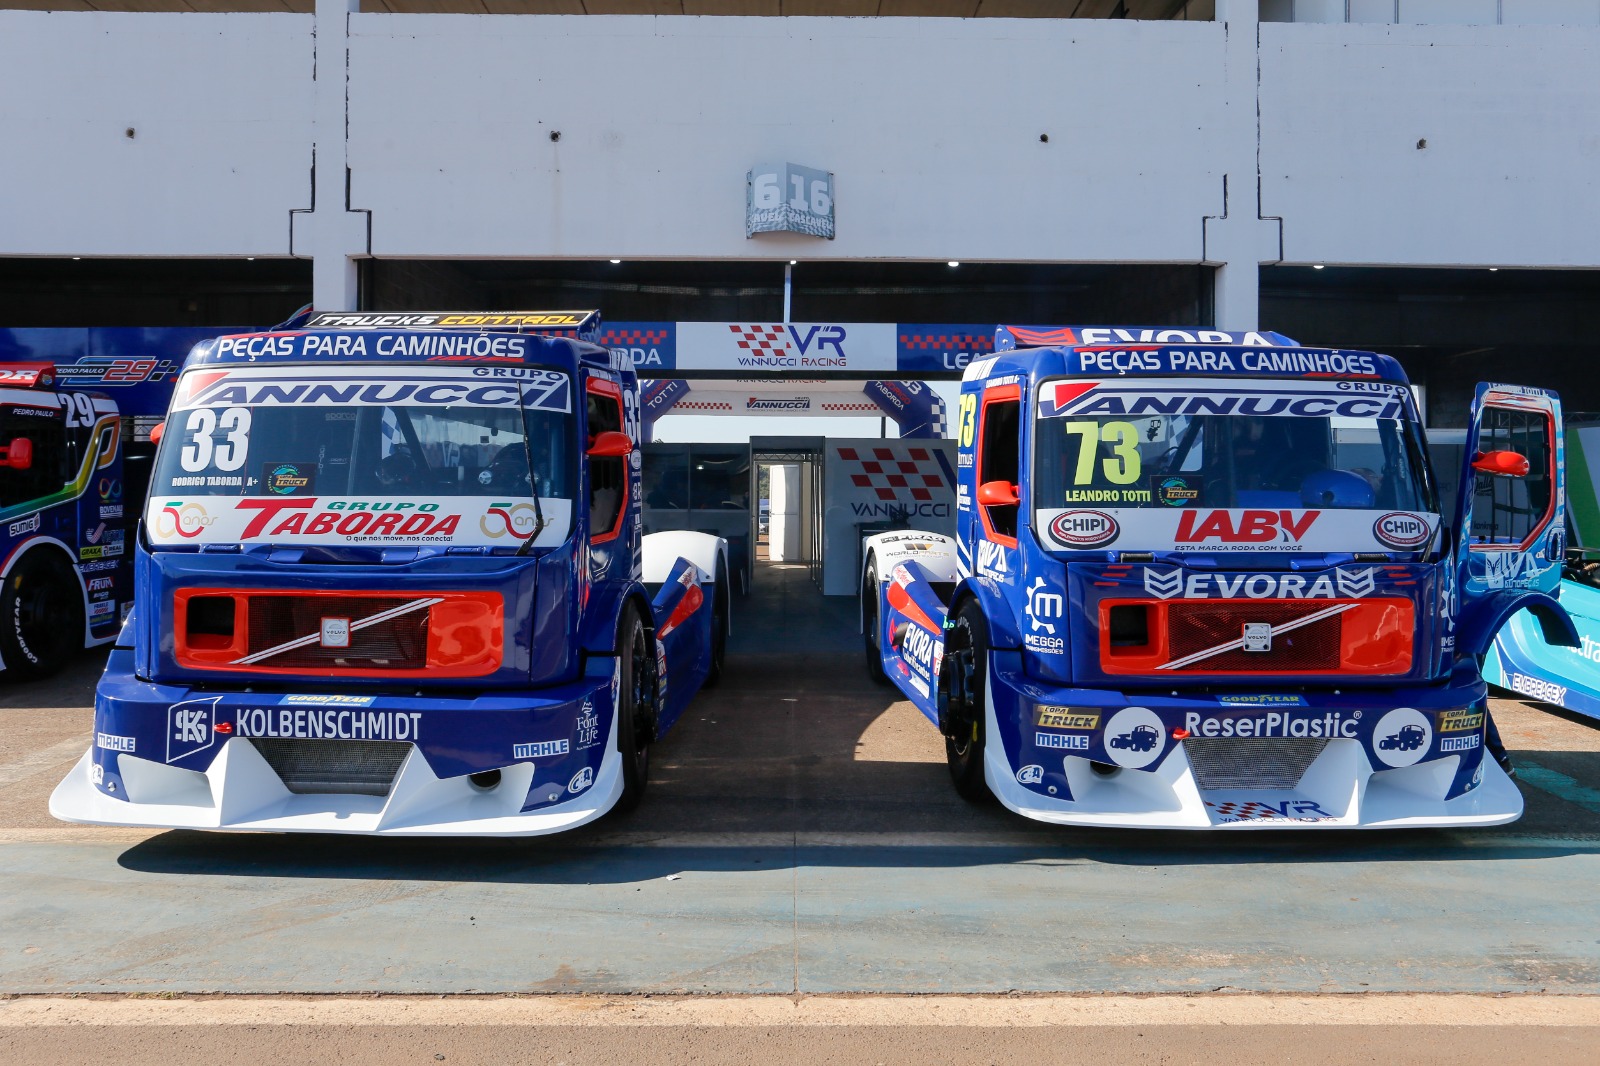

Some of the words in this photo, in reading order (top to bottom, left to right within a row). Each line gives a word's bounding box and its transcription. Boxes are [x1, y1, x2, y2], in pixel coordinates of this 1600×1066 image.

[754, 173, 781, 209] 6
[789, 174, 830, 216] 16
[319, 314, 439, 326] TRUCKS
[438, 313, 581, 326] CONTROL
[217, 336, 295, 361] PEÇAS
[302, 336, 367, 356] PARA
[375, 333, 525, 358] CAMINHÕES
[102, 359, 159, 382] 29
[737, 357, 797, 367] VANNUCCI
[801, 357, 847, 367] RACING
[1080, 350, 1161, 375] PEÇAS
[1169, 351, 1236, 371] PARA
[1241, 350, 1376, 375] CAMINHÕES
[472, 367, 563, 381] GRUPO
[647, 381, 678, 409] TOTTI
[874, 381, 904, 411] TABORDA
[1336, 381, 1407, 396] GRUPO
[13, 408, 34, 416] PEDRO
[34, 409, 54, 417] PAULO
[57, 392, 96, 428] 29
[181, 407, 252, 473] 33
[1065, 421, 1142, 486] 73
[172, 476, 205, 487] RODRIGO
[206, 476, 242, 487] TABORDA
[1065, 490, 1119, 502] LEANDRO
[1121, 490, 1151, 502] TOTTI
[327, 501, 441, 513] GRUPO
[850, 502, 950, 519] VANNUCCI
[234, 498, 461, 541] TABORDA
[1060, 518, 1106, 532] CHIPI
[1383, 520, 1421, 534] CHIPI
[81, 547, 102, 556] GRAXA
[88, 577, 113, 592] FRUM
[1184, 573, 1336, 599] EVORA
[903, 622, 934, 668] EVORA
[287, 694, 371, 703] GOODYEAR
[1222, 694, 1299, 702] GOODYEAR
[1512, 673, 1567, 707] EMBREAGEX
[235, 709, 421, 740] KOLBENSCHMIDT
[576, 714, 599, 731] Font
[1042, 714, 1096, 728] TRUCK
[1444, 716, 1482, 730] TRUCK
[98, 733, 135, 751] MAHLE
[579, 727, 599, 744] Life
[1036, 734, 1089, 749] MAHLE
[1441, 735, 1479, 750] MAHLE
[514, 740, 568, 758] MAHLE
